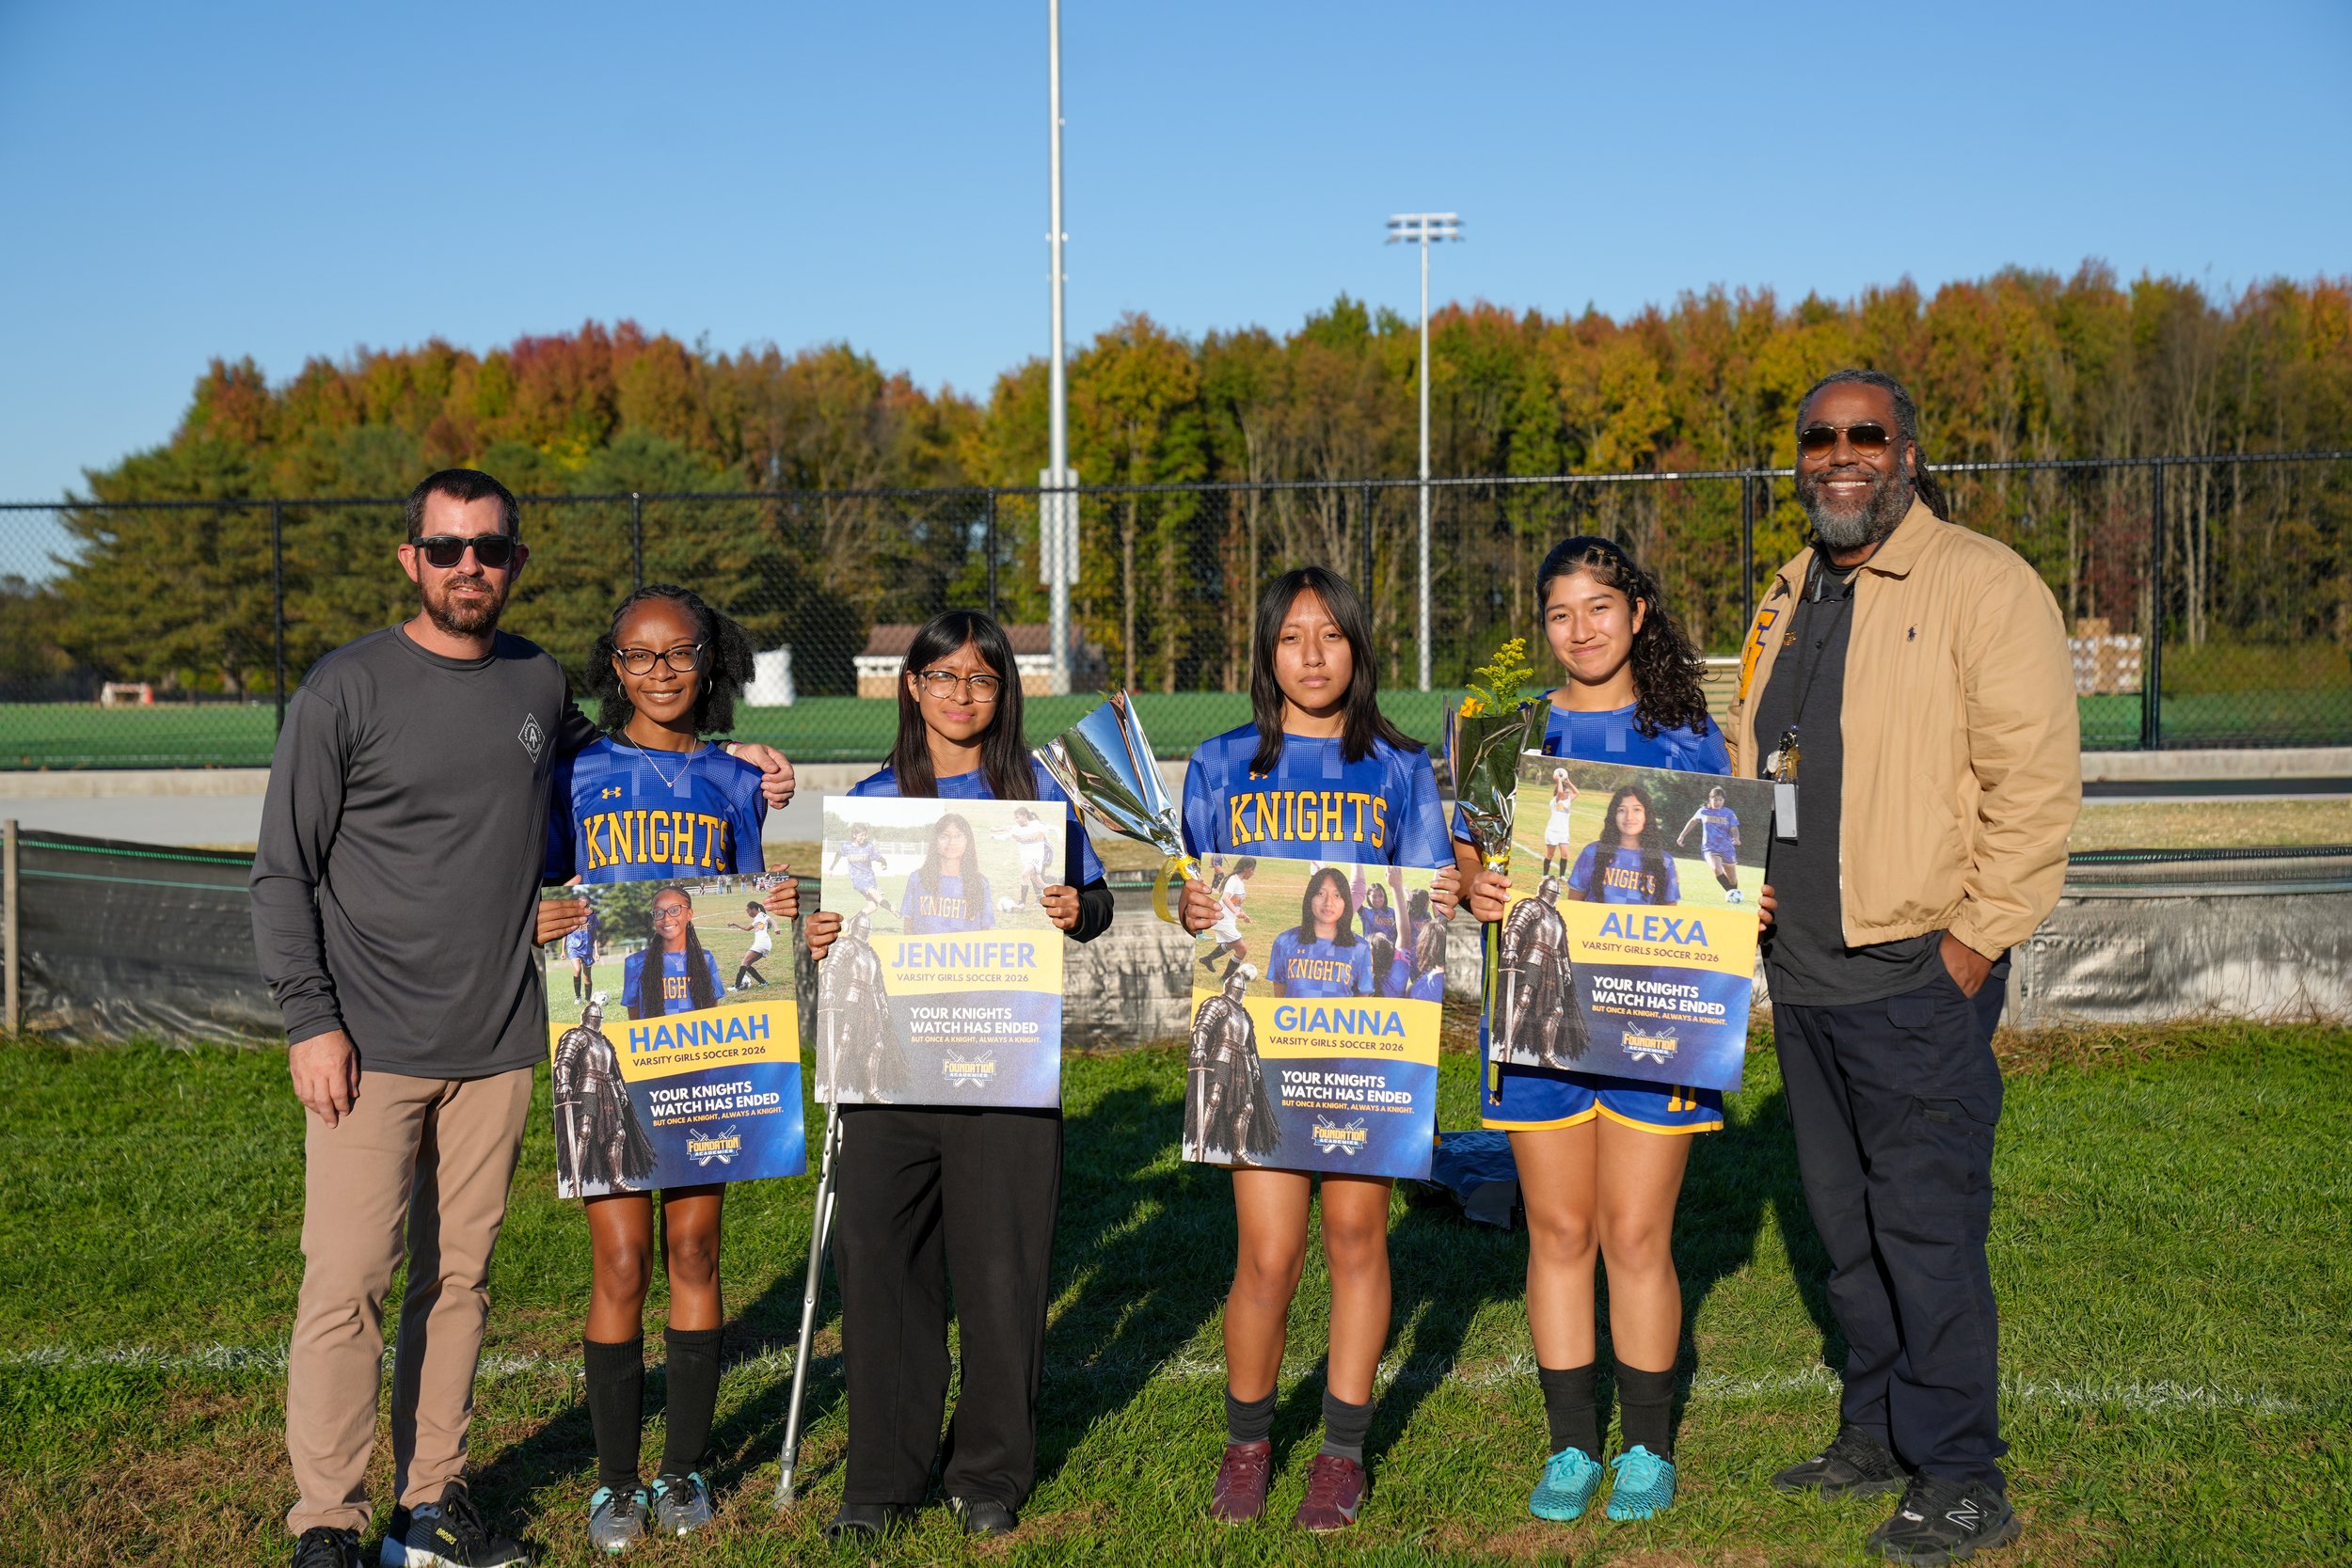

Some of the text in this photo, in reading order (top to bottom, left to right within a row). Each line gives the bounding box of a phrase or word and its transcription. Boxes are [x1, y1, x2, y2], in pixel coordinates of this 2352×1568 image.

[1230, 790, 1387, 848] KNIGHTS
[583, 810, 729, 872] KNIGHTS
[920, 895, 976, 921] KNIGHT
[1598, 911, 1708, 946] ALEXA
[891, 942, 1038, 968] JENNIFER
[1582, 941, 1719, 962] VARSITY GIRLS SOCCER 2026
[938, 974, 963, 982] GIRLS
[1288, 958, 1352, 985] KNIGHTS
[1593, 975, 1699, 998] YOUR KNIGHTS
[1592, 990, 1725, 1015] WATCH HAS ENDED
[911, 1007, 1011, 1020] YOUR KNIGHTS
[1274, 1006, 1406, 1037] GIANNA
[1633, 1010, 1661, 1019] KNIGHT,
[629, 1014, 770, 1053] HANNAH
[911, 1022, 1039, 1034] WATCH HAS ENDED
[1270, 1037, 1404, 1052] VARSITY GIRLS SOCCER 2026
[1624, 1033, 1676, 1052] FOUNDATION
[633, 1046, 766, 1067] VARSITY GIRLS SOCCER 2026
[945, 1061, 993, 1073] FOUNDATION
[1281, 1070, 1386, 1088] YOUR KNIGHTS
[649, 1081, 752, 1102] YOUR KNIGHTS
[1281, 1085, 1412, 1104] WATCH HAS ENDED
[650, 1093, 779, 1117] WATCH HAS ENDED
[693, 1114, 720, 1122] KNIGHT,
[1314, 1126, 1364, 1141] FOUNDATION
[689, 1137, 739, 1152] FOUNDATION
[436, 1528, 457, 1545] BROOKS
